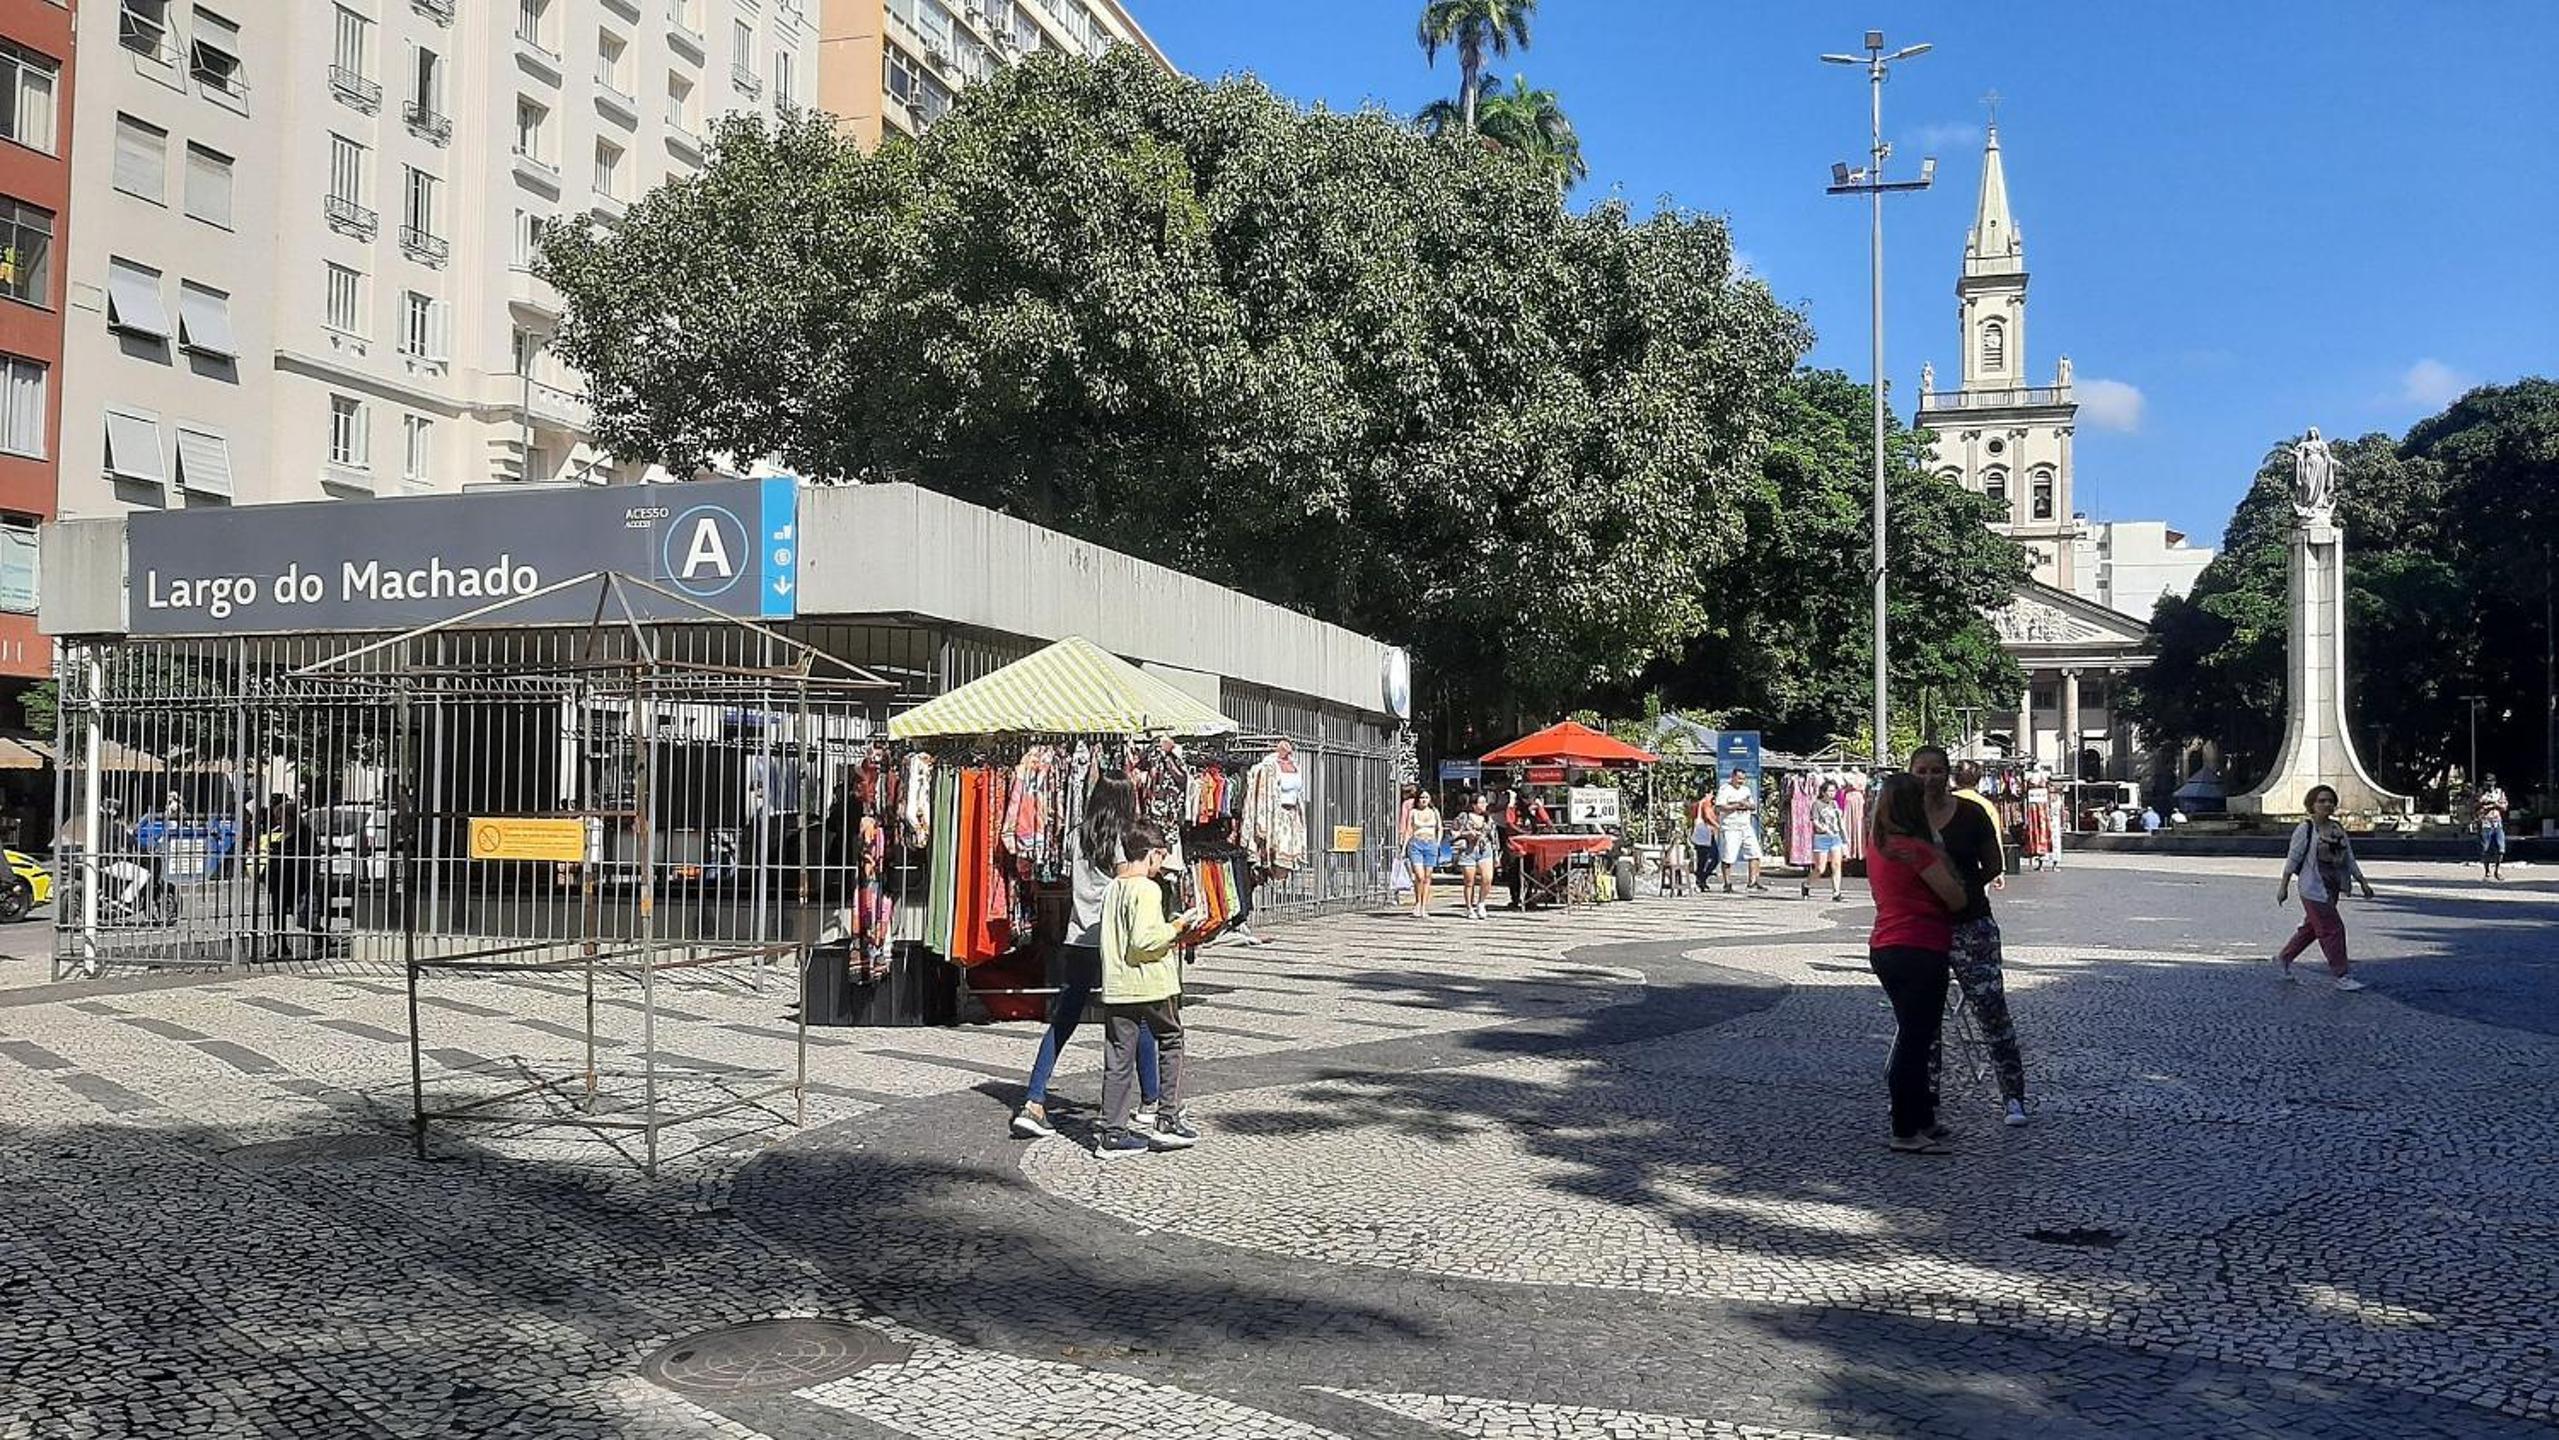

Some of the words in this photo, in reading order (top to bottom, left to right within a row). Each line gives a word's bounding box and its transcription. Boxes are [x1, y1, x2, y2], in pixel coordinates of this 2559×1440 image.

[625, 507, 669, 519] ACESSO
[682, 518, 732, 578] A
[148, 570, 257, 618] Largo
[274, 562, 324, 604] do
[342, 553, 538, 601] Machado
